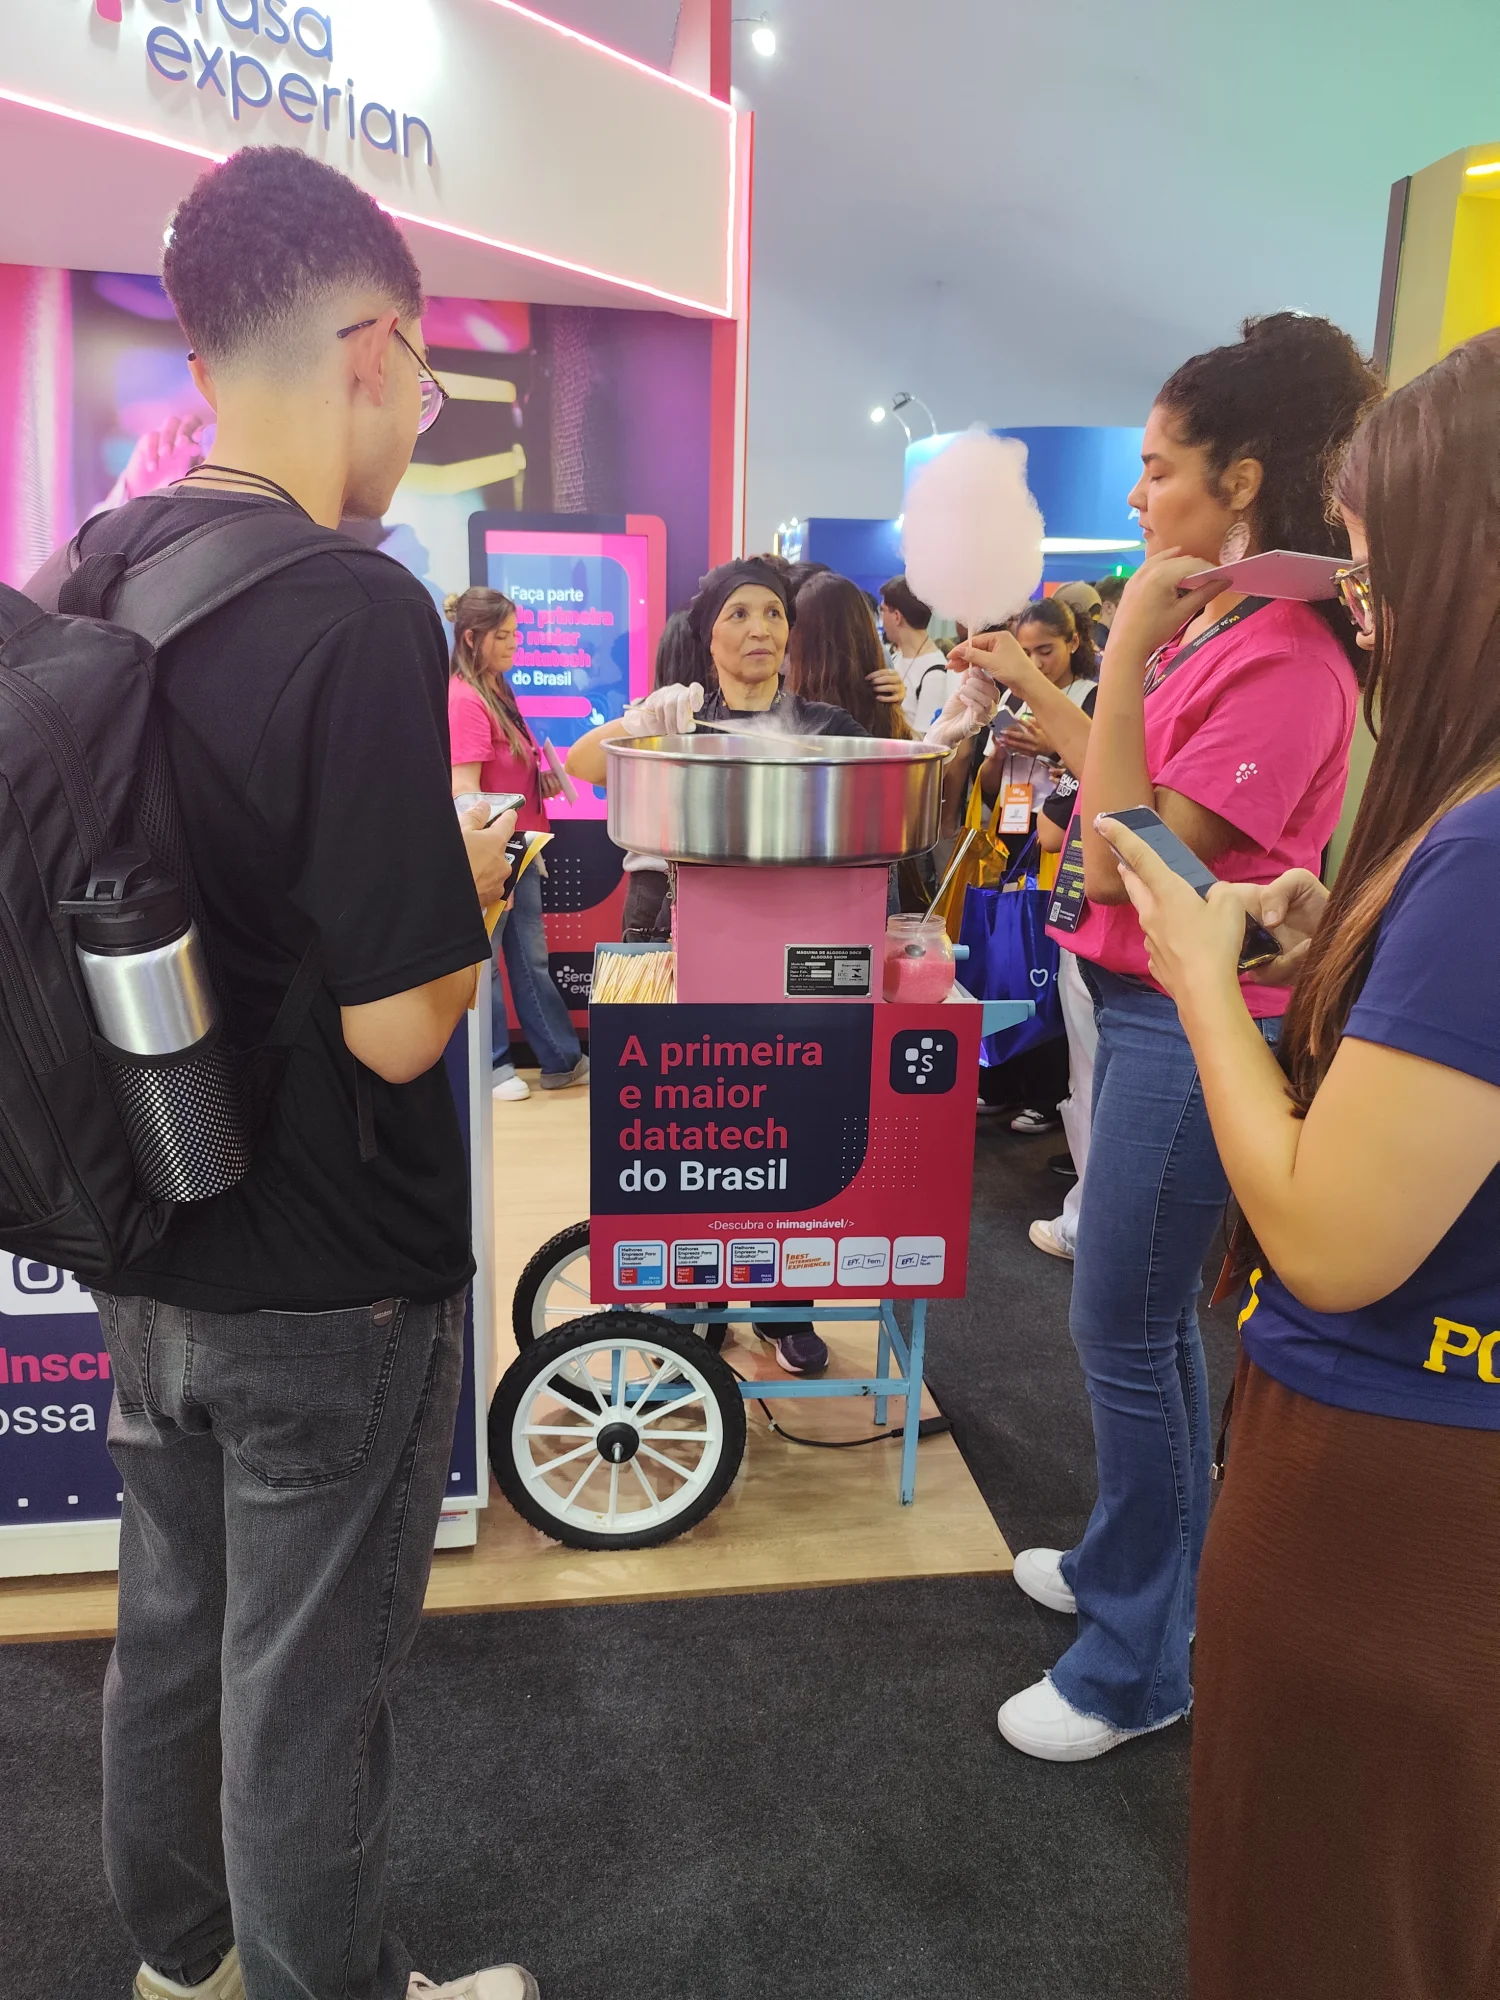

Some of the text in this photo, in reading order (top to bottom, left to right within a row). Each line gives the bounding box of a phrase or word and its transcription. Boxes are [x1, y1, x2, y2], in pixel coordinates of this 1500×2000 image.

[145, 25, 433, 166] experian
[510, 586, 584, 604] Faça parte
[538, 606, 614, 628] primeira
[527, 628, 580, 646] maior
[512, 647, 592, 668] datatech
[512, 670, 572, 686] do Brasil
[618, 1034, 823, 1075] A primeira
[619, 1076, 767, 1108] e maior
[619, 1118, 788, 1150] datatech
[618, 1158, 788, 1192] do Brasil
